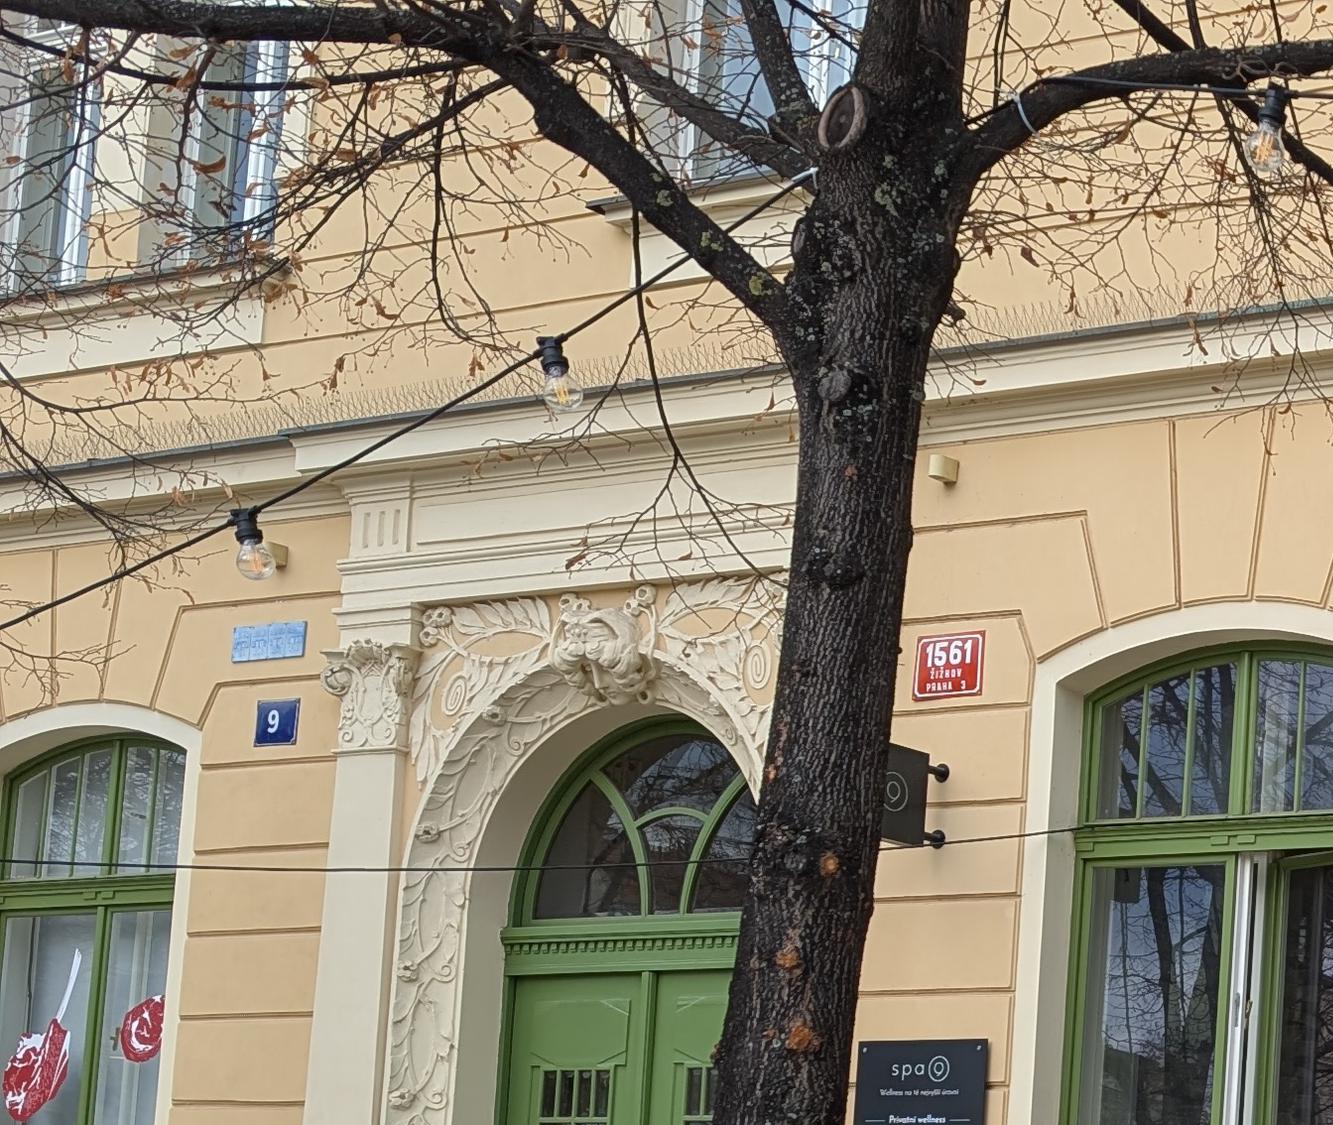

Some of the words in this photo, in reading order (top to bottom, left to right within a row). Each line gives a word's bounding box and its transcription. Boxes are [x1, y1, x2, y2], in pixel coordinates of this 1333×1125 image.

[926, 640, 973, 667] 1561
[926, 682, 953, 692] PRAHA
[960, 680, 967, 690] 3
[267, 709, 280, 734] 9
[917, 1114, 947, 1124] wellness
